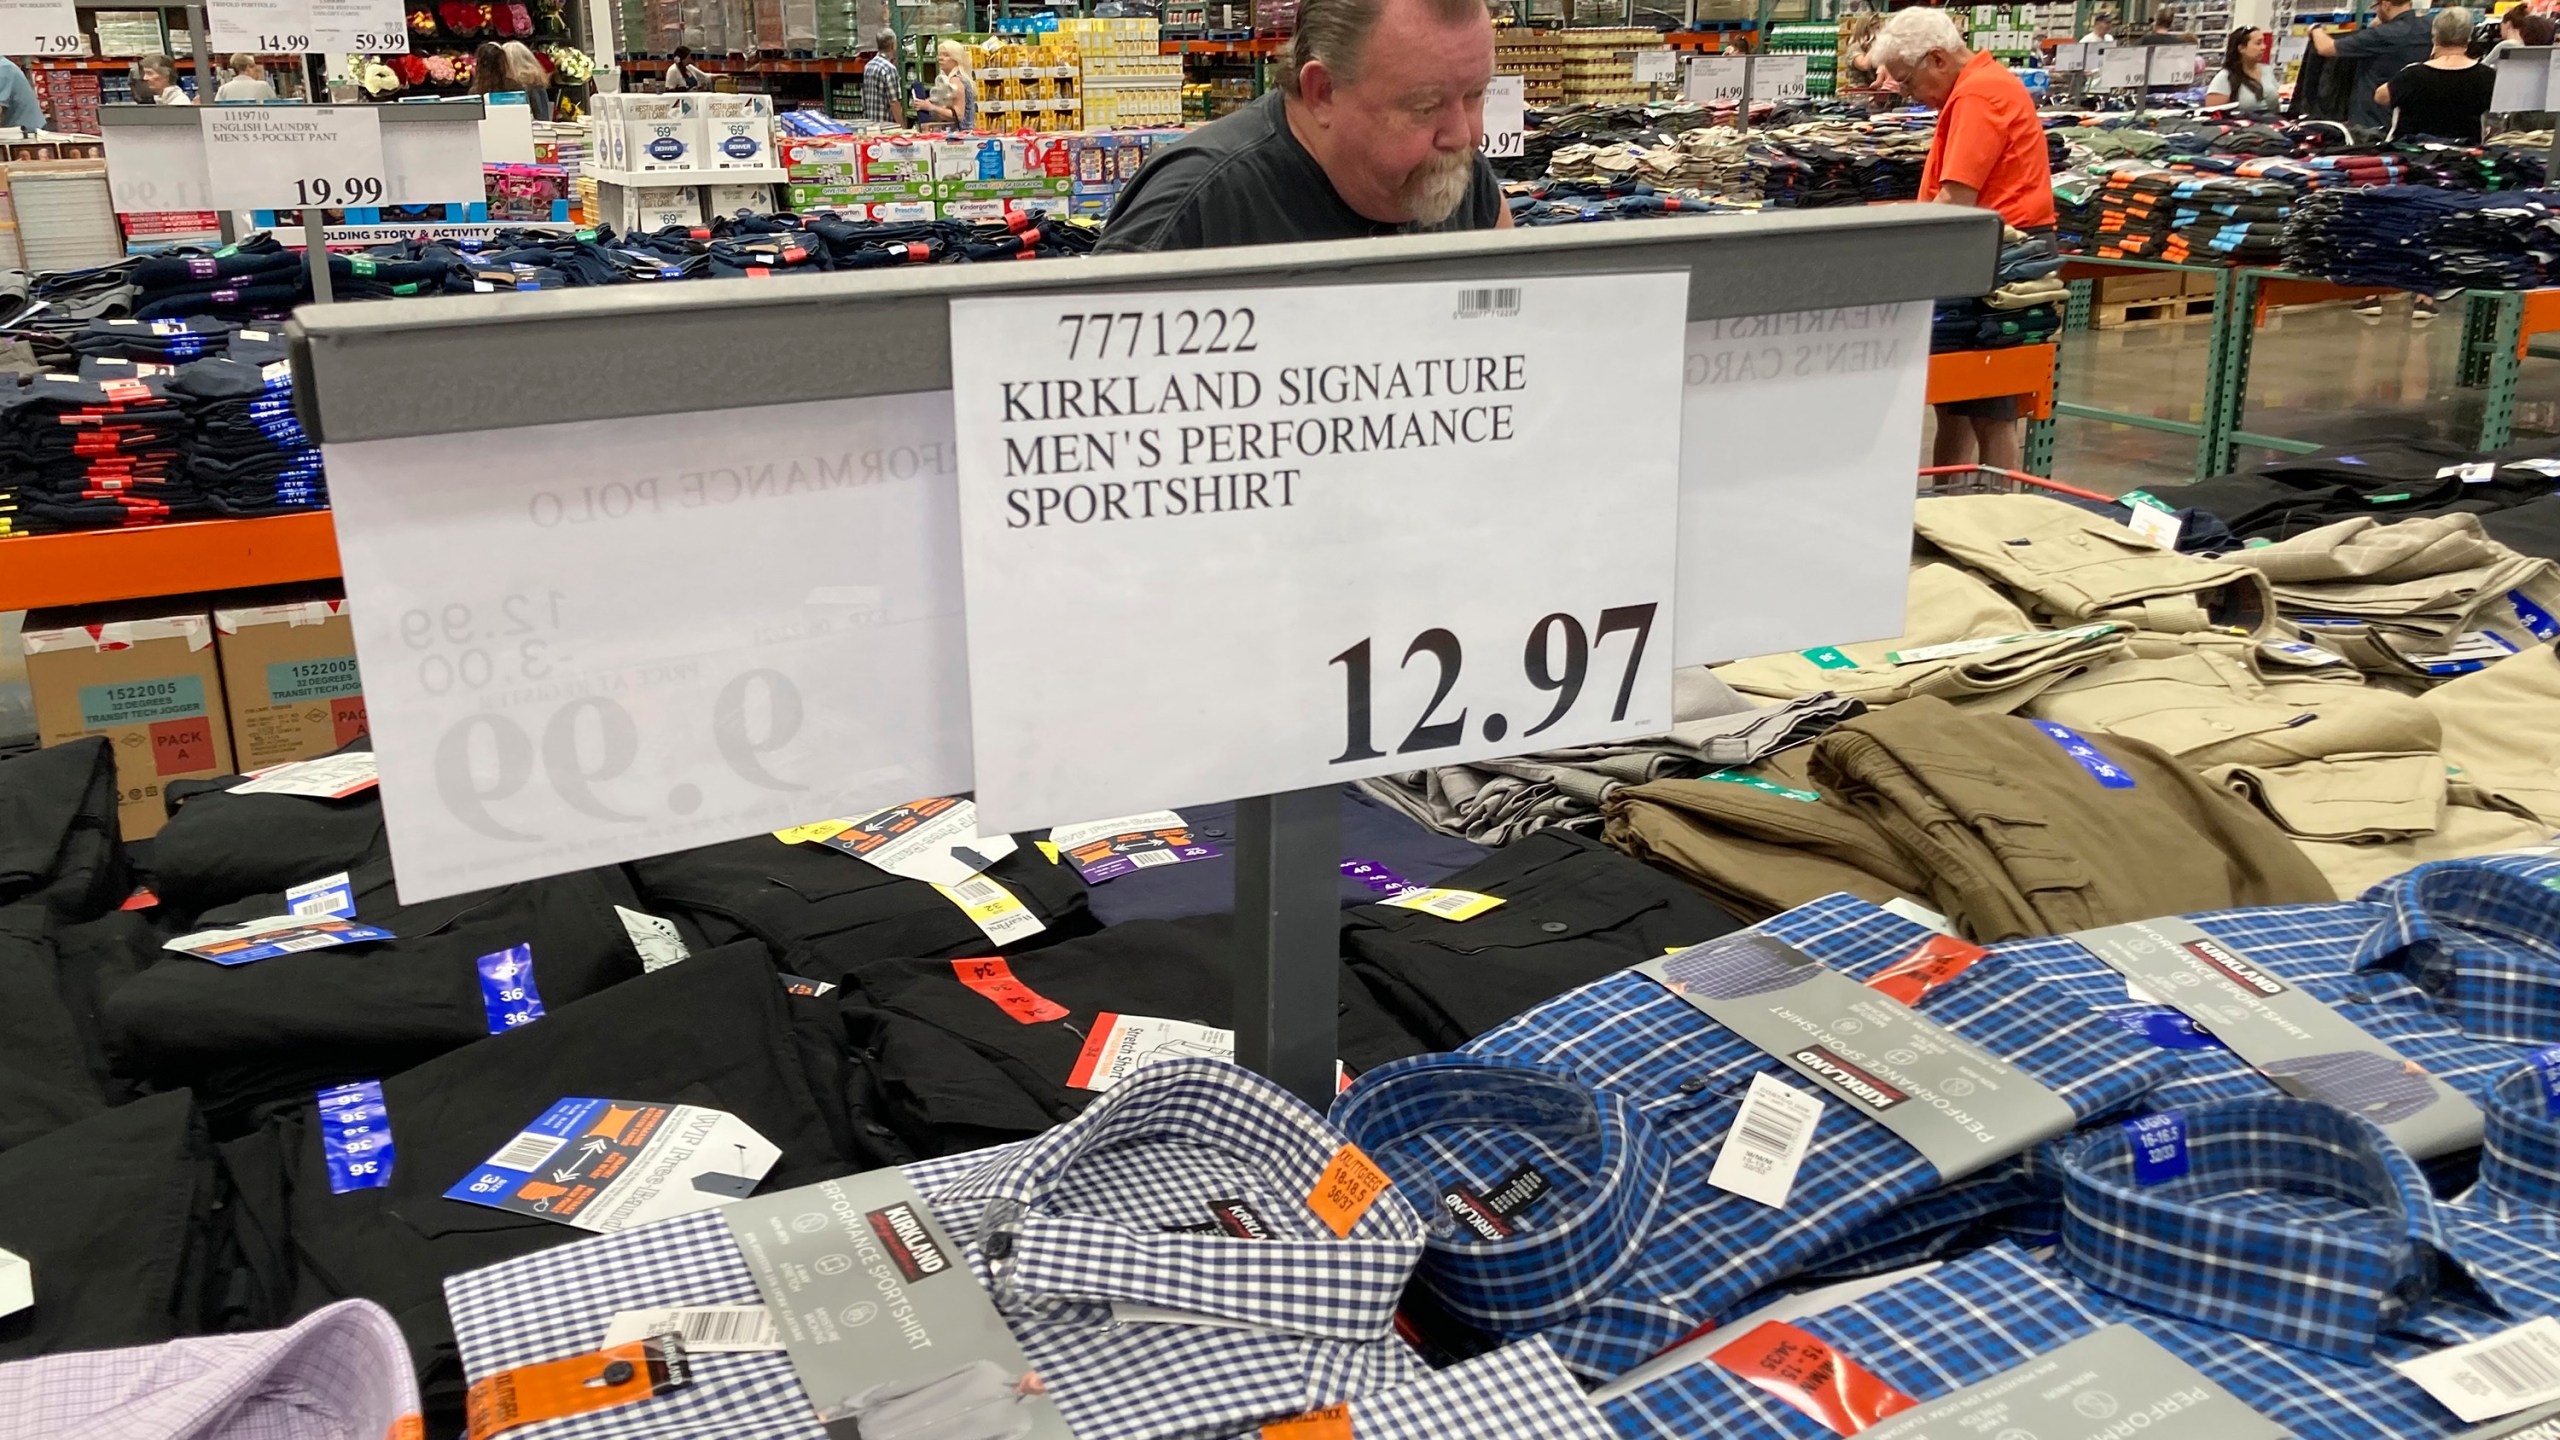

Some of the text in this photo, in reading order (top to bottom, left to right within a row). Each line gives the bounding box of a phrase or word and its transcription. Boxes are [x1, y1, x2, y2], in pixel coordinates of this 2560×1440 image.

[35, 35, 79, 53] 7.99
[258, 35, 310, 51] 14.99
[355, 34, 406, 50] 59.99
[1655, 71, 1675, 81] 12.99
[2125, 74, 2144, 85] 9.99
[2170, 72, 2193, 84] 12.99
[1715, 87, 1742, 99] 14.99
[1777, 84, 1804, 96] 14.99
[224, 111, 270, 121] 1119710
[212, 123, 319, 132] ENGLISH LAUNDRY
[252, 133, 305, 142] 5-POCKET
[308, 132, 339, 142] PANT
[294, 177, 384, 206] 19.99
[960, 203, 998, 211] Kindergarten
[373, 228, 491, 240] STORY & ACTIVITY
[1059, 306, 1259, 362] 7771222
[1001, 354, 1527, 423] KIRKLAND SIGNATURE
[1003, 405, 1515, 478] MEN'S PERFORMANCE
[1005, 468, 1303, 530] SPORTSHIRT
[2520, 613, 2538, 628] 36
[2538, 628, 2554, 640] 36
[292, 660, 357, 678] 1522005
[296, 673, 353, 688] 32 DEGREES
[1328, 601, 1659, 766] 12.97
[107, 682, 176, 701] 1522005
[271, 688, 313, 700] TRANSIT
[313, 685, 340, 696] TECH
[111, 696, 173, 711] 32 DEGREES
[85, 702, 201, 724] TRANSIT TECH JOGGER
[356, 725, 369, 735] A
[157, 732, 202, 747] PACK
[177, 748, 190, 760] A
[1353, 864, 1372, 874] 40
[973, 962, 994, 980] 34
[2193, 939, 2288, 996] KIRKLAND
[499, 988, 525, 1001] 36
[504, 1010, 530, 1025] 36
[2214, 980, 2315, 1041] SPORTSHIRT
[1118, 1026, 1145, 1056] Stretch
[1085, 1045, 1101, 1060] 34
[1107, 1055, 1127, 1080] Short
[1768, 1004, 1997, 1145] PERFORMANCE SPORTSHIRT
[1796, 1050, 1895, 1108] KIRKLAND
[337, 1092, 364, 1105] 36
[340, 1110, 368, 1123] 36
[343, 1125, 371, 1137] 36
[2141, 1126, 2179, 1148] 16-16.5
[345, 1139, 373, 1154] 36
[348, 1160, 379, 1177] 36
[467, 1173, 501, 1194] 36
[488, 1178, 508, 1194] SIZE
[598, 1144, 698, 1233] Free-Band
[1334, 1168, 1367, 1202] 18-18.5
[1326, 1184, 1355, 1213] 36/37
[1444, 1193, 1504, 1241] KIRKLAND
[884, 1205, 946, 1275] KIRKLAND
[817, 1179, 932, 1351] ERFORMANCE SPORTSHIRT
[777, 1261, 803, 1294] STRETCH
[780, 1307, 809, 1344] ELASTANE
[813, 1305, 842, 1345] MOISTURE
[662, 1335, 684, 1387] KIRKLAND
